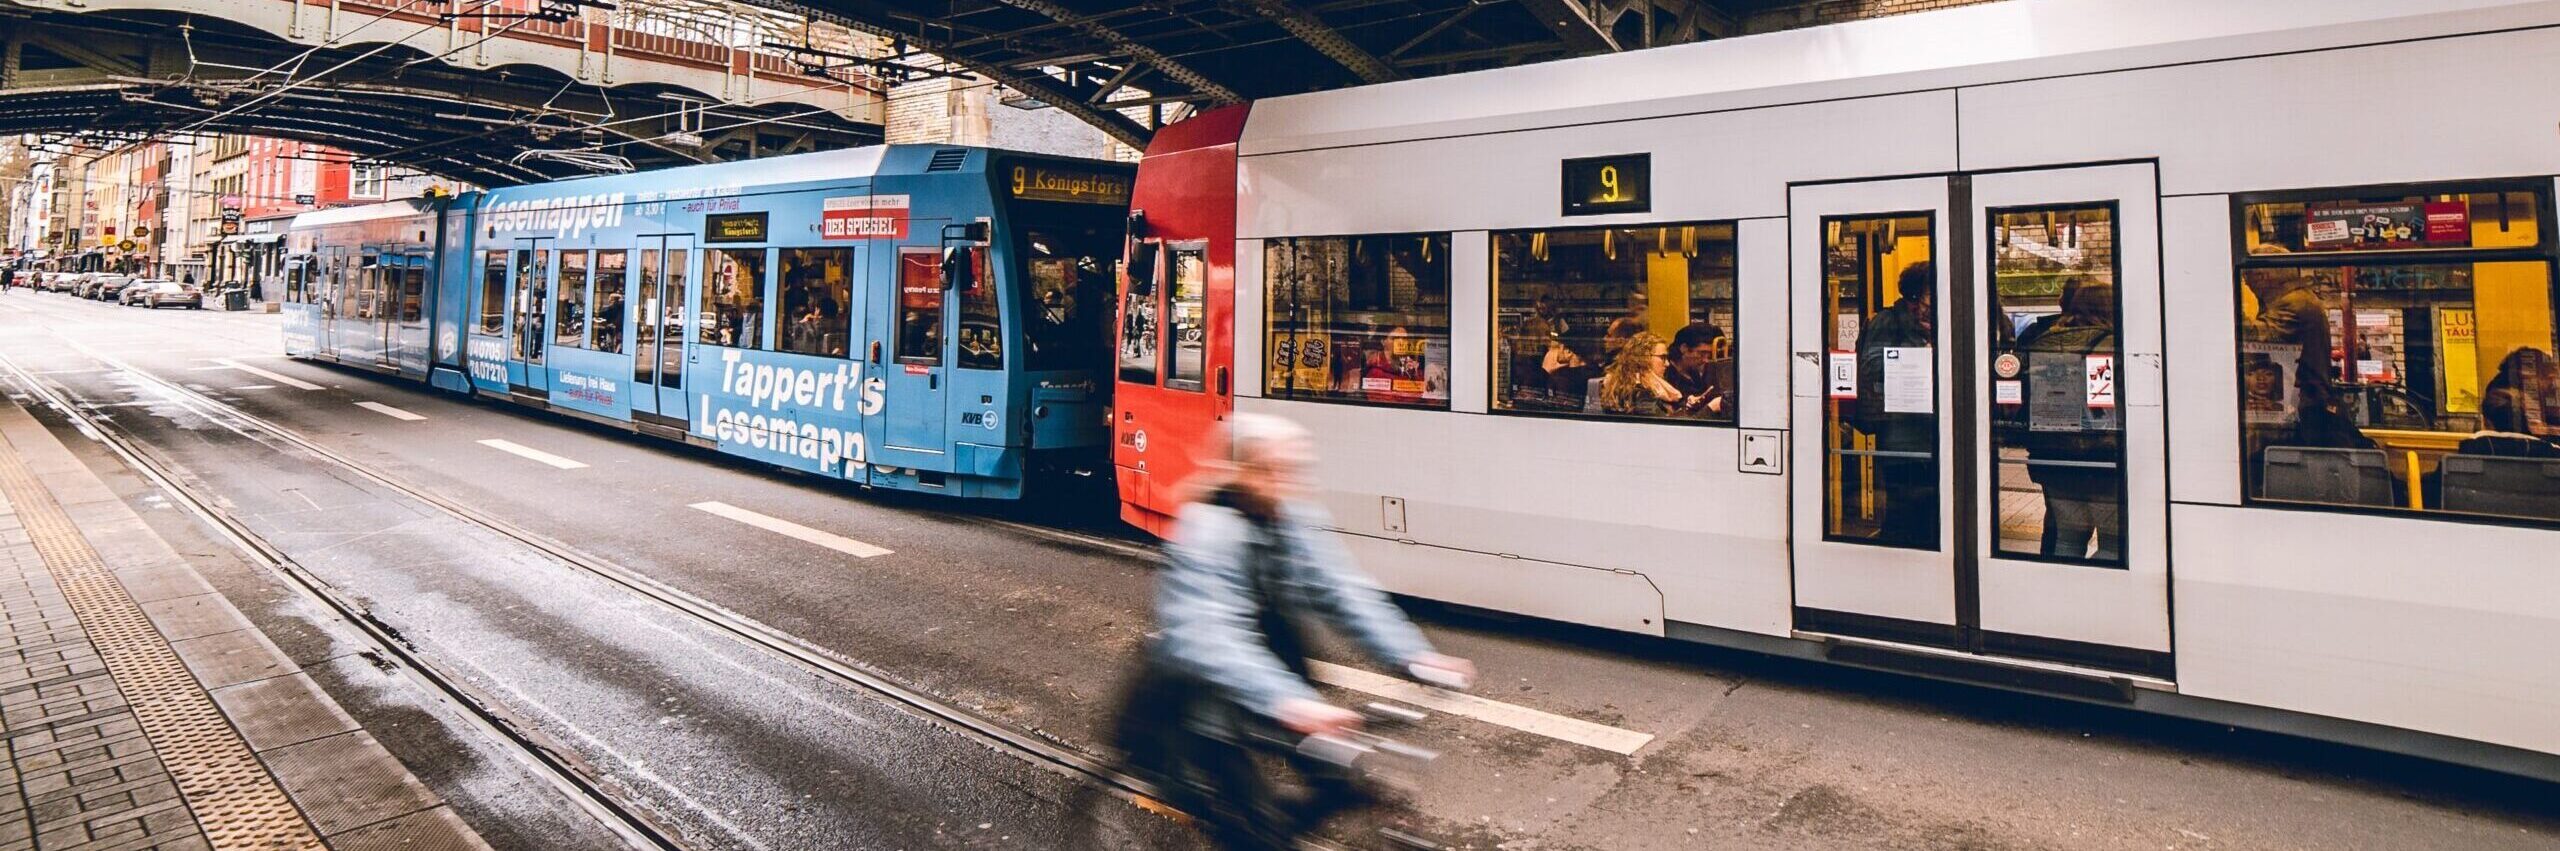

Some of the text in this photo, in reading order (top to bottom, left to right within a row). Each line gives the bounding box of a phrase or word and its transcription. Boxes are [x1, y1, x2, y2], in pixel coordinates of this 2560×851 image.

[1013, 166, 1026, 196] 9
[1601, 165, 1619, 202] 9
[707, 199, 717, 211] für
[719, 198, 740, 210] Privat
[881, 197, 900, 207] mehr
[482, 191, 626, 240] Lesemappen
[825, 216, 897, 236] DER SPIEGEL
[559, 370, 616, 393] Lieferung frei Haus
[722, 349, 886, 416] Tappert's
[962, 412, 983, 425] KVB
[1121, 432, 1136, 446] KVB
